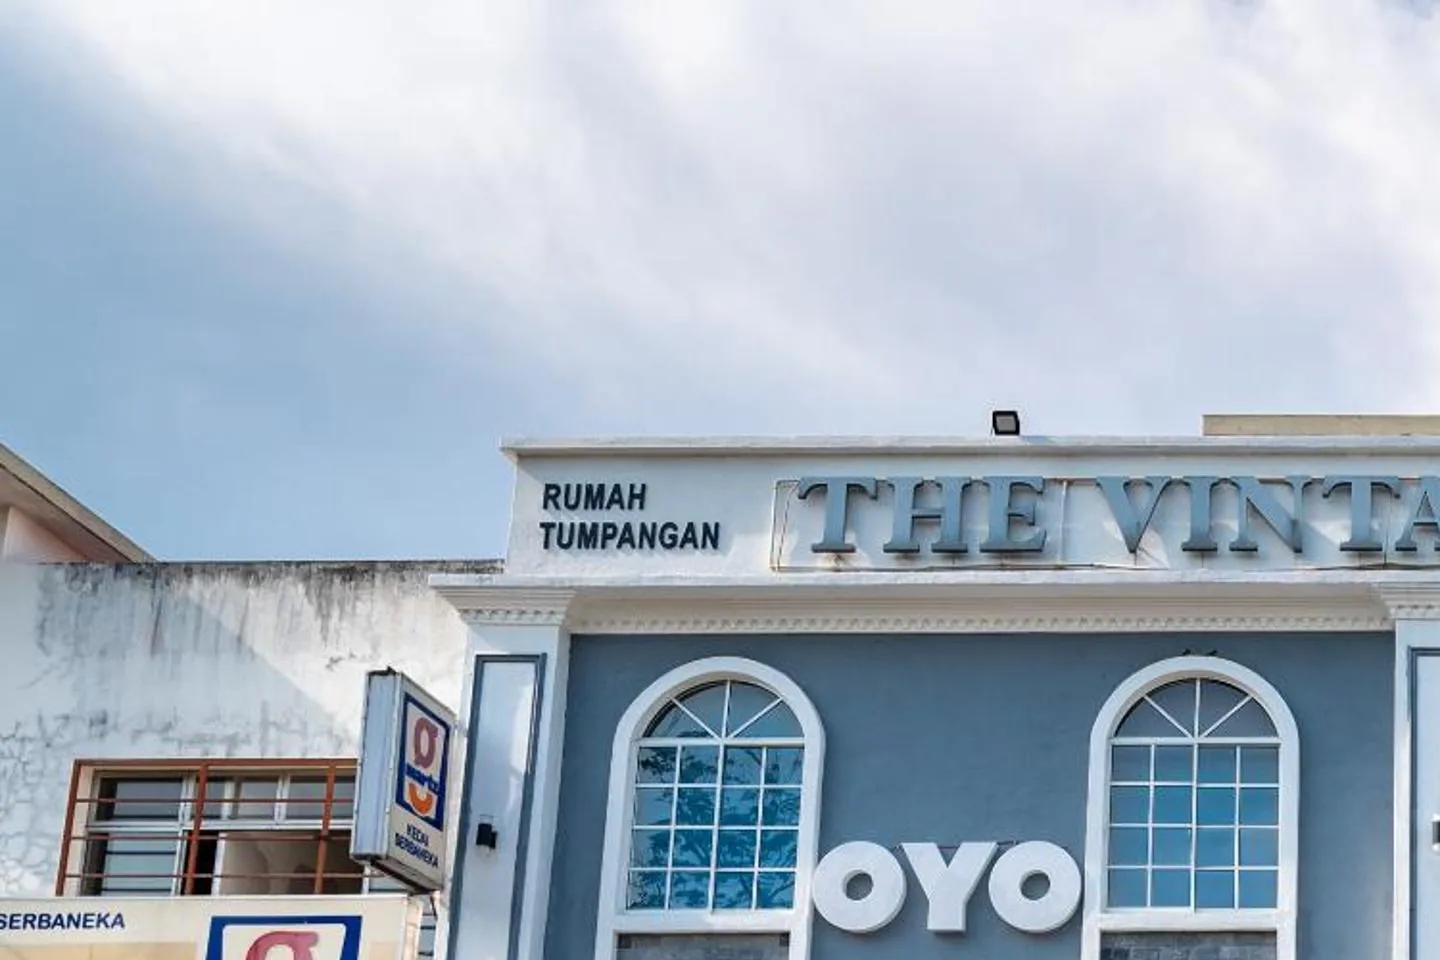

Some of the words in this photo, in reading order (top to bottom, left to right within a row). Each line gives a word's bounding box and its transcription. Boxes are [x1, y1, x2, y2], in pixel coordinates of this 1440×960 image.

[542, 483, 647, 511] RUMAH
[798, 476, 1047, 553] THE
[539, 521, 720, 550] TUMPANGAN
[812, 840, 1082, 932] OYO
[0, 912, 125, 930] SERBANEKA
